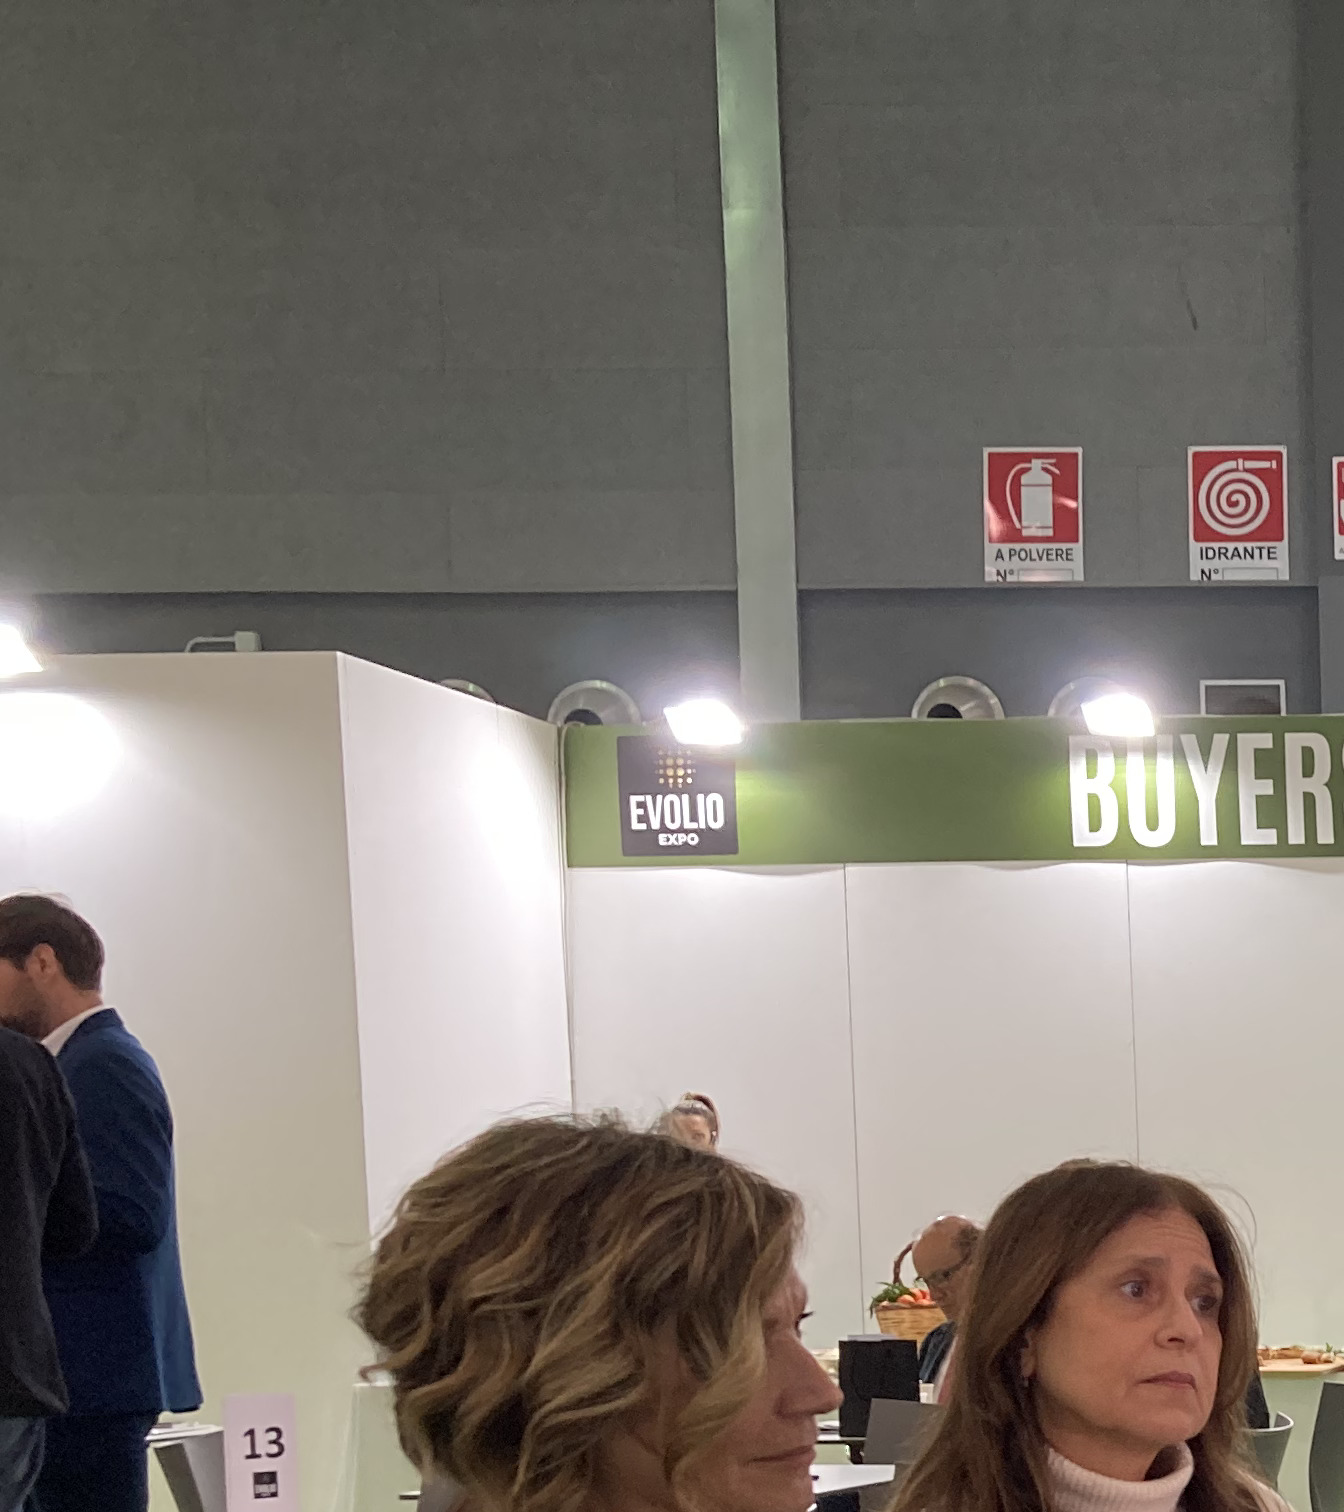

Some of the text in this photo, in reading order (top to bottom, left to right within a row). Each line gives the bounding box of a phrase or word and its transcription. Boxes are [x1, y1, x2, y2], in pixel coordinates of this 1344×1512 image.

[995, 548, 1074, 561] A POLVERE
[1200, 546, 1278, 560] IDRANTE
[629, 792, 725, 830] EVOLIO
[658, 832, 699, 846] EXPO
[243, 1426, 285, 1459] 13
